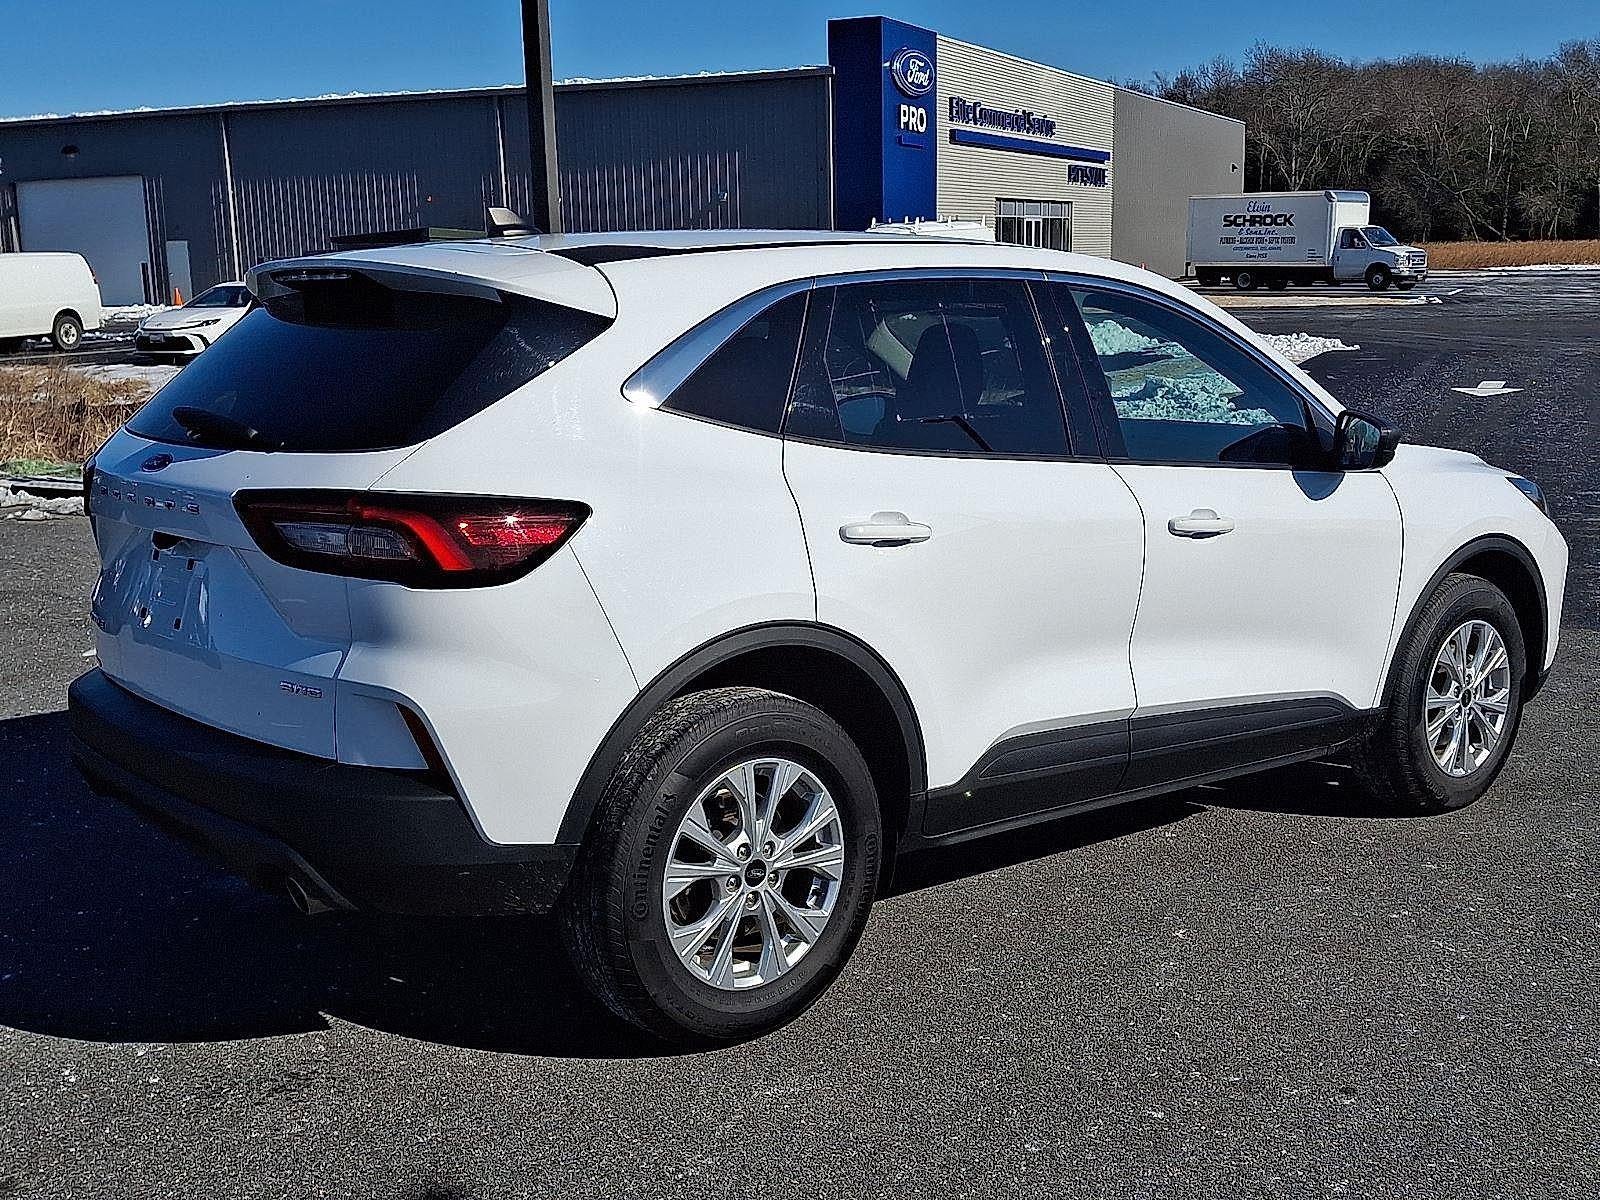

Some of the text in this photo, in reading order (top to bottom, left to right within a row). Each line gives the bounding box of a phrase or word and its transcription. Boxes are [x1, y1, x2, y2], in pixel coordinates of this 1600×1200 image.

[907, 58, 930, 86] Ford
[900, 104, 927, 132] PRO
[949, 96, 973, 124] Elite
[1222, 213, 1295, 228] SCHROCK
[1247, 200, 1271, 213] Elvin
[631, 803, 671, 920] Continental
